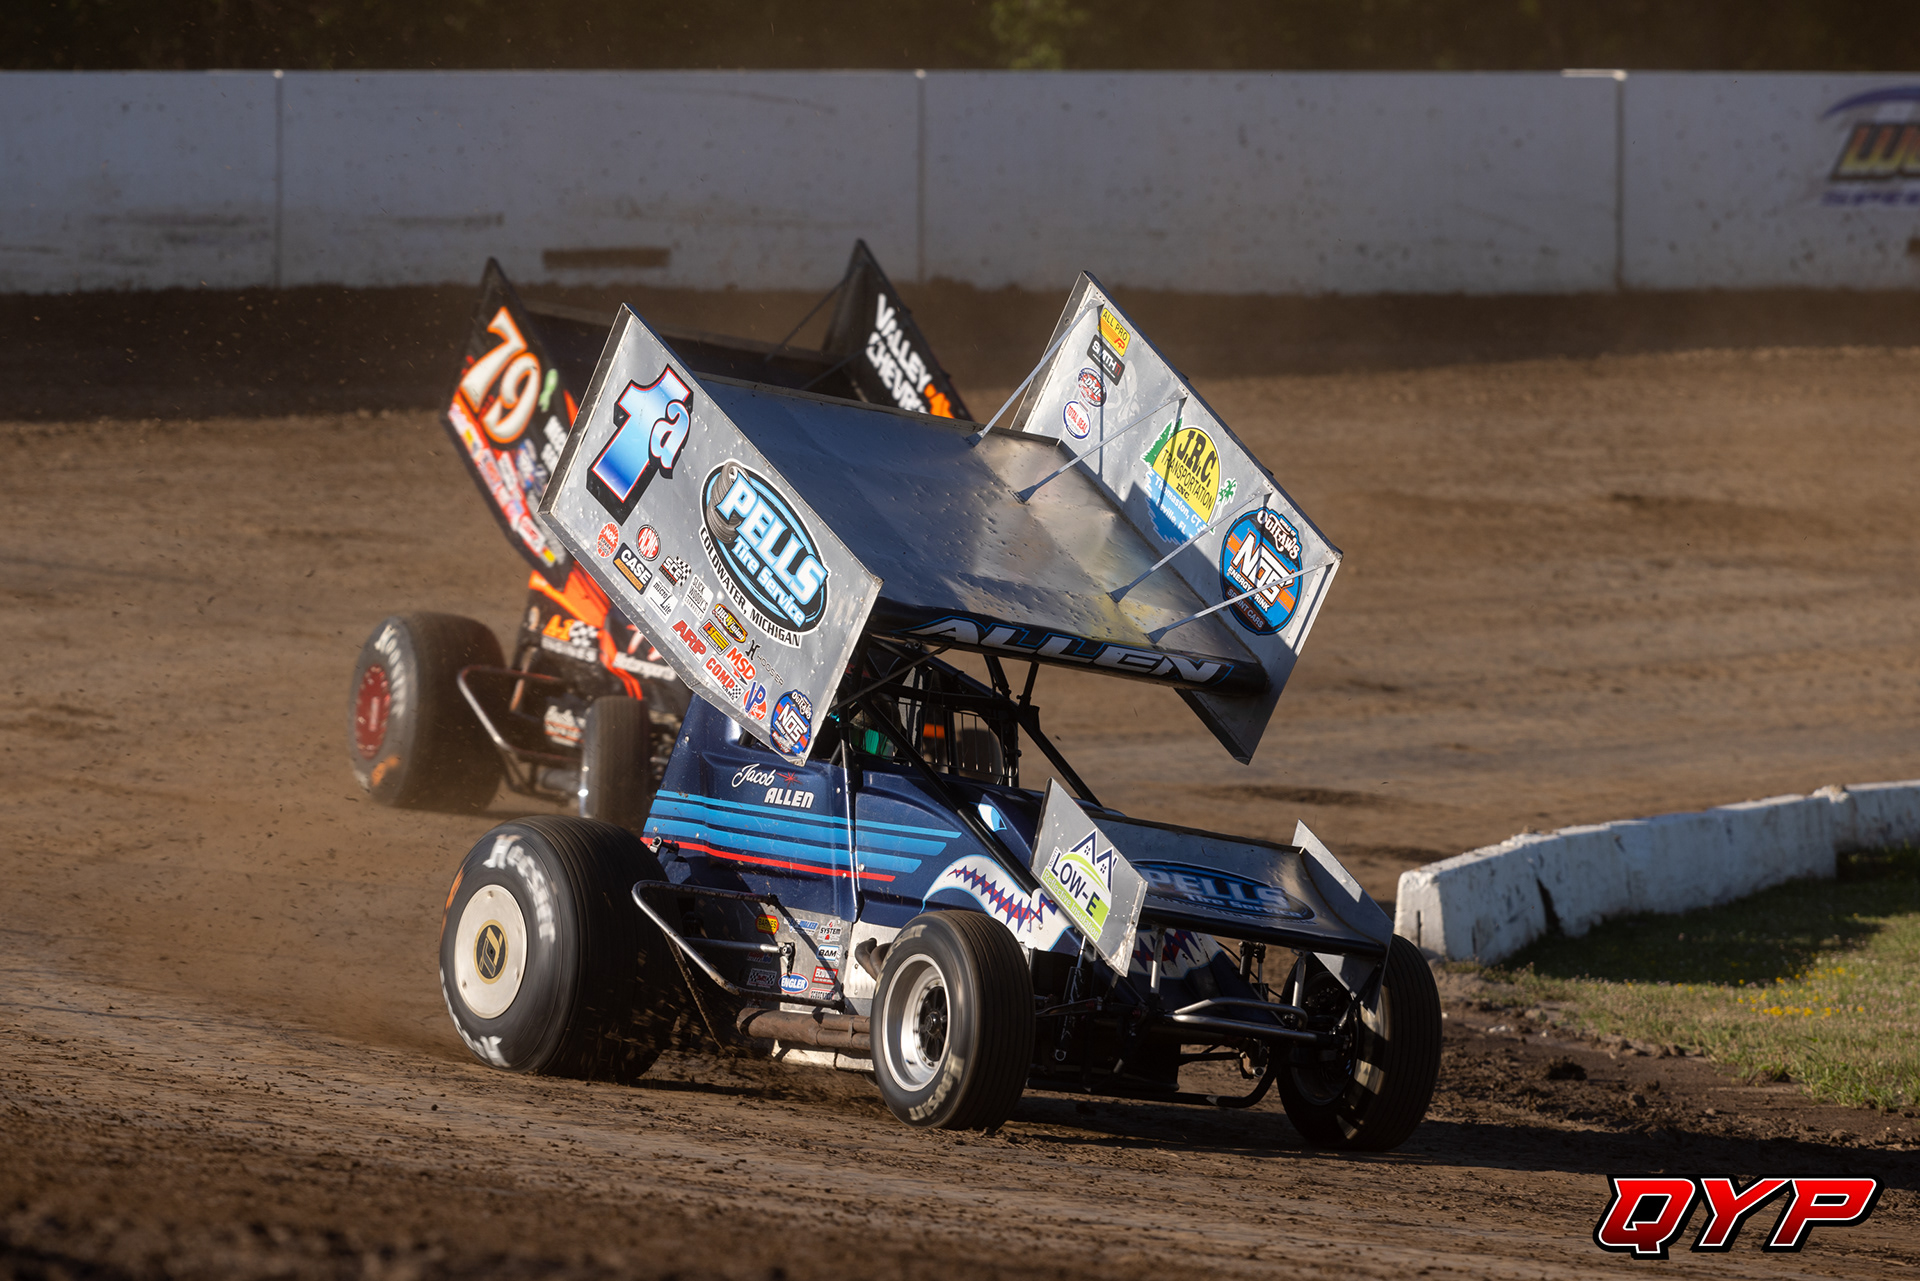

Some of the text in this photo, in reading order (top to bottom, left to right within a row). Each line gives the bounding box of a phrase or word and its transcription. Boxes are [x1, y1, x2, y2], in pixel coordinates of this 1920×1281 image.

[1102, 310, 1128, 341] ALL PRO
[459, 305, 541, 443] 79
[1084, 376, 1101, 396] DMI
[1066, 405, 1077, 423] TOTAL
[1076, 417, 1088, 434] SEAL
[1160, 449, 1214, 511] TRANSPORTATION
[1176, 482, 1190, 501] INC.
[603, 528, 618, 544] NGK
[1177, 520, 1187, 535] FL
[1191, 513, 1202, 527] CT
[716, 471, 828, 605] PELLS
[621, 549, 652, 585] CASE
[663, 557, 683, 582] SCE
[732, 535, 806, 627] Tire Service
[1231, 532, 1294, 604] NOS
[700, 527, 747, 614] COLDWATER,
[750, 608, 800, 647] MICHIGAN
[1227, 565, 1271, 612] ENERGY RINK
[1227, 588, 1264, 628] SPINT CARS
[672, 619, 707, 655] ARP
[909, 618, 1222, 683] ALLEN
[705, 657, 735, 689] COMP
[726, 647, 755, 680] MSD
[757, 655, 784, 686] HOOSIER
[745, 681, 766, 713] VP
[778, 703, 808, 744] NOS
[731, 763, 776, 788] Jacob
[764, 787, 815, 809] ALLEN
[1051, 852, 1101, 917] LOW-E
[1138, 865, 1290, 909] PELLS
[1042, 870, 1099, 940] Reflective Insulation
[818, 949, 837, 957] BAM
[780, 977, 806, 989] ENGLER
